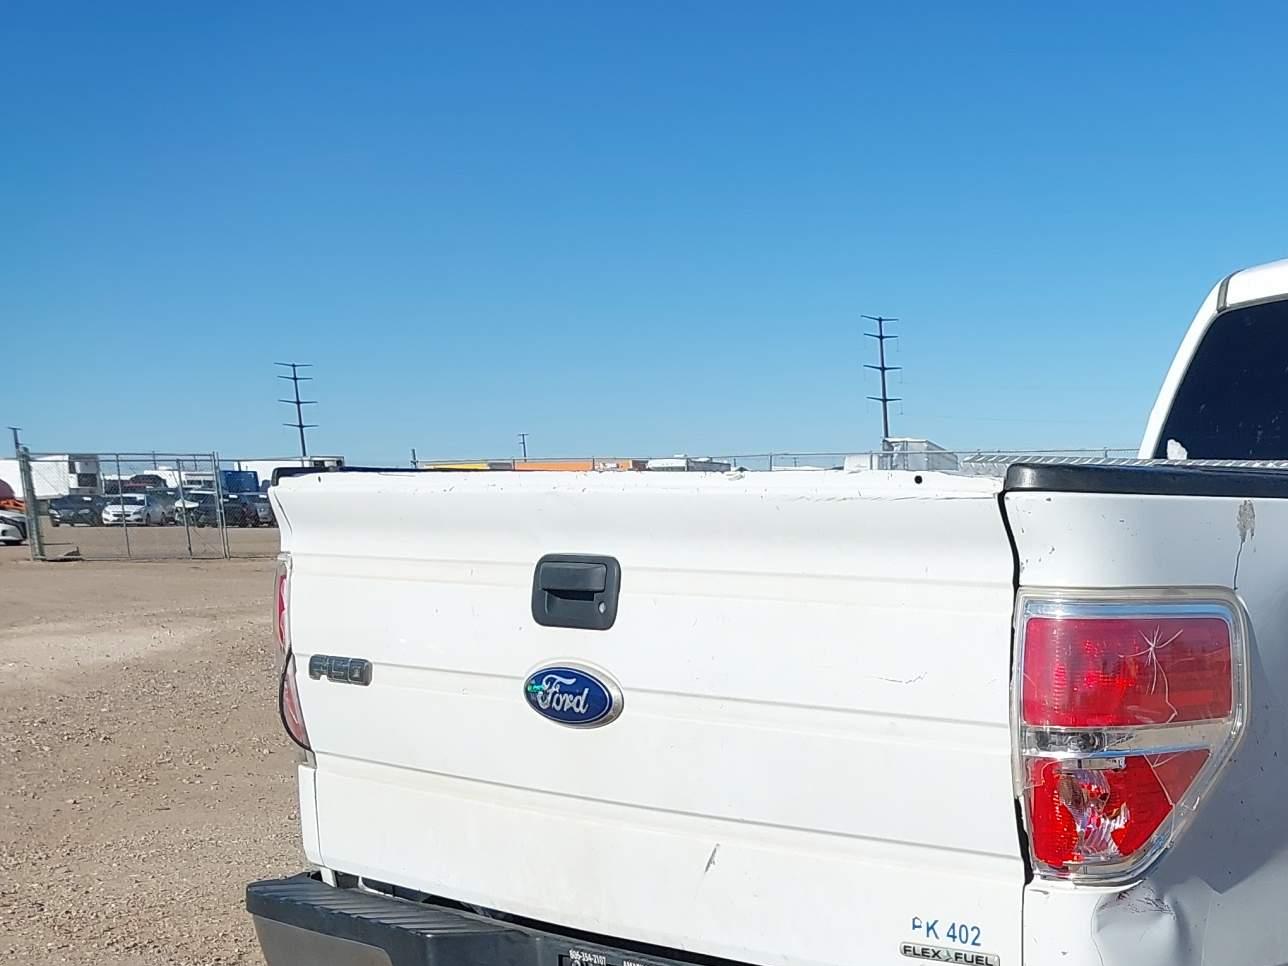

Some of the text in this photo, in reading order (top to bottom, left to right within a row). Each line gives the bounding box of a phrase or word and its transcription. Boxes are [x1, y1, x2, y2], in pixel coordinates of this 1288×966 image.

[537, 674, 589, 714] Ford
[946, 922, 982, 946] 402
[903, 944, 942, 960] FLEX
